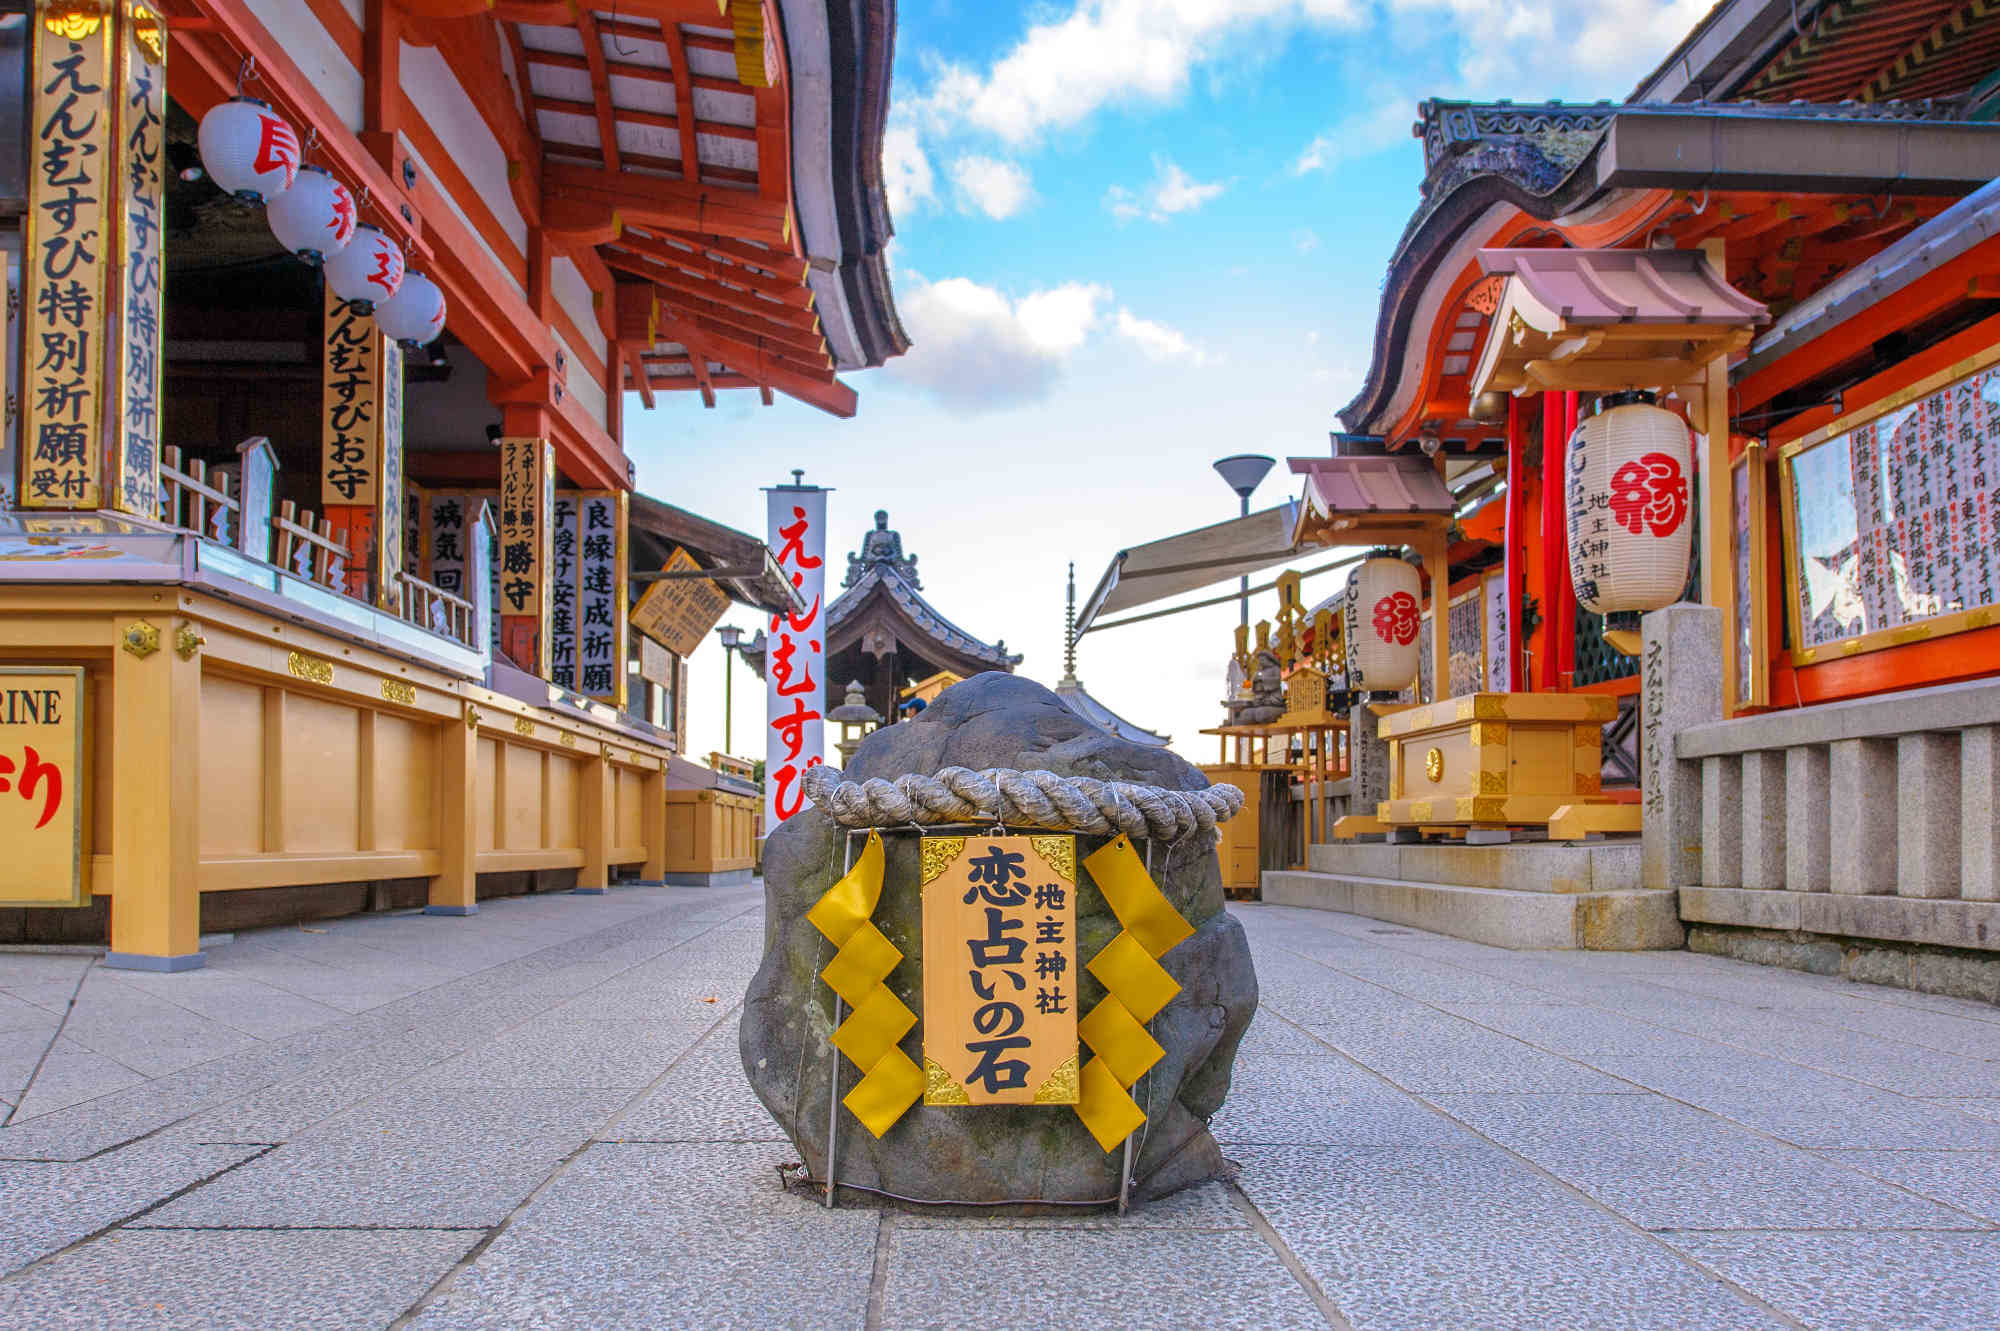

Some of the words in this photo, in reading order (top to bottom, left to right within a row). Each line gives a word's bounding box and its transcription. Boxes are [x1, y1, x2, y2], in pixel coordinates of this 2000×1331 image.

[34, 43, 101, 467] えんむすび特別祈願
[125, 65, 162, 479] えんむすび特別祈願
[31, 468, 91, 500] 受付
[124, 477, 157, 518] 受付
[503, 442, 518, 539] ライバルに勝つ
[520, 443, 536, 539] スポーツに勝つ
[1608, 452, 1689, 538] 縁
[502, 540, 536, 612] 勝守
[1588, 492, 1611, 579] 地主神社
[553, 501, 576, 692] 子授け安産祈願
[582, 500, 614, 692] 良縁達成祈願
[1372, 591, 1421, 646] 縁
[0, 689, 62, 725] INE
[769, 506, 823, 821] えんむすび
[0, 745, 63, 830] り
[962, 845, 1032, 1095] 恋占いの石
[1034, 883, 1069, 1015] 地主神社
